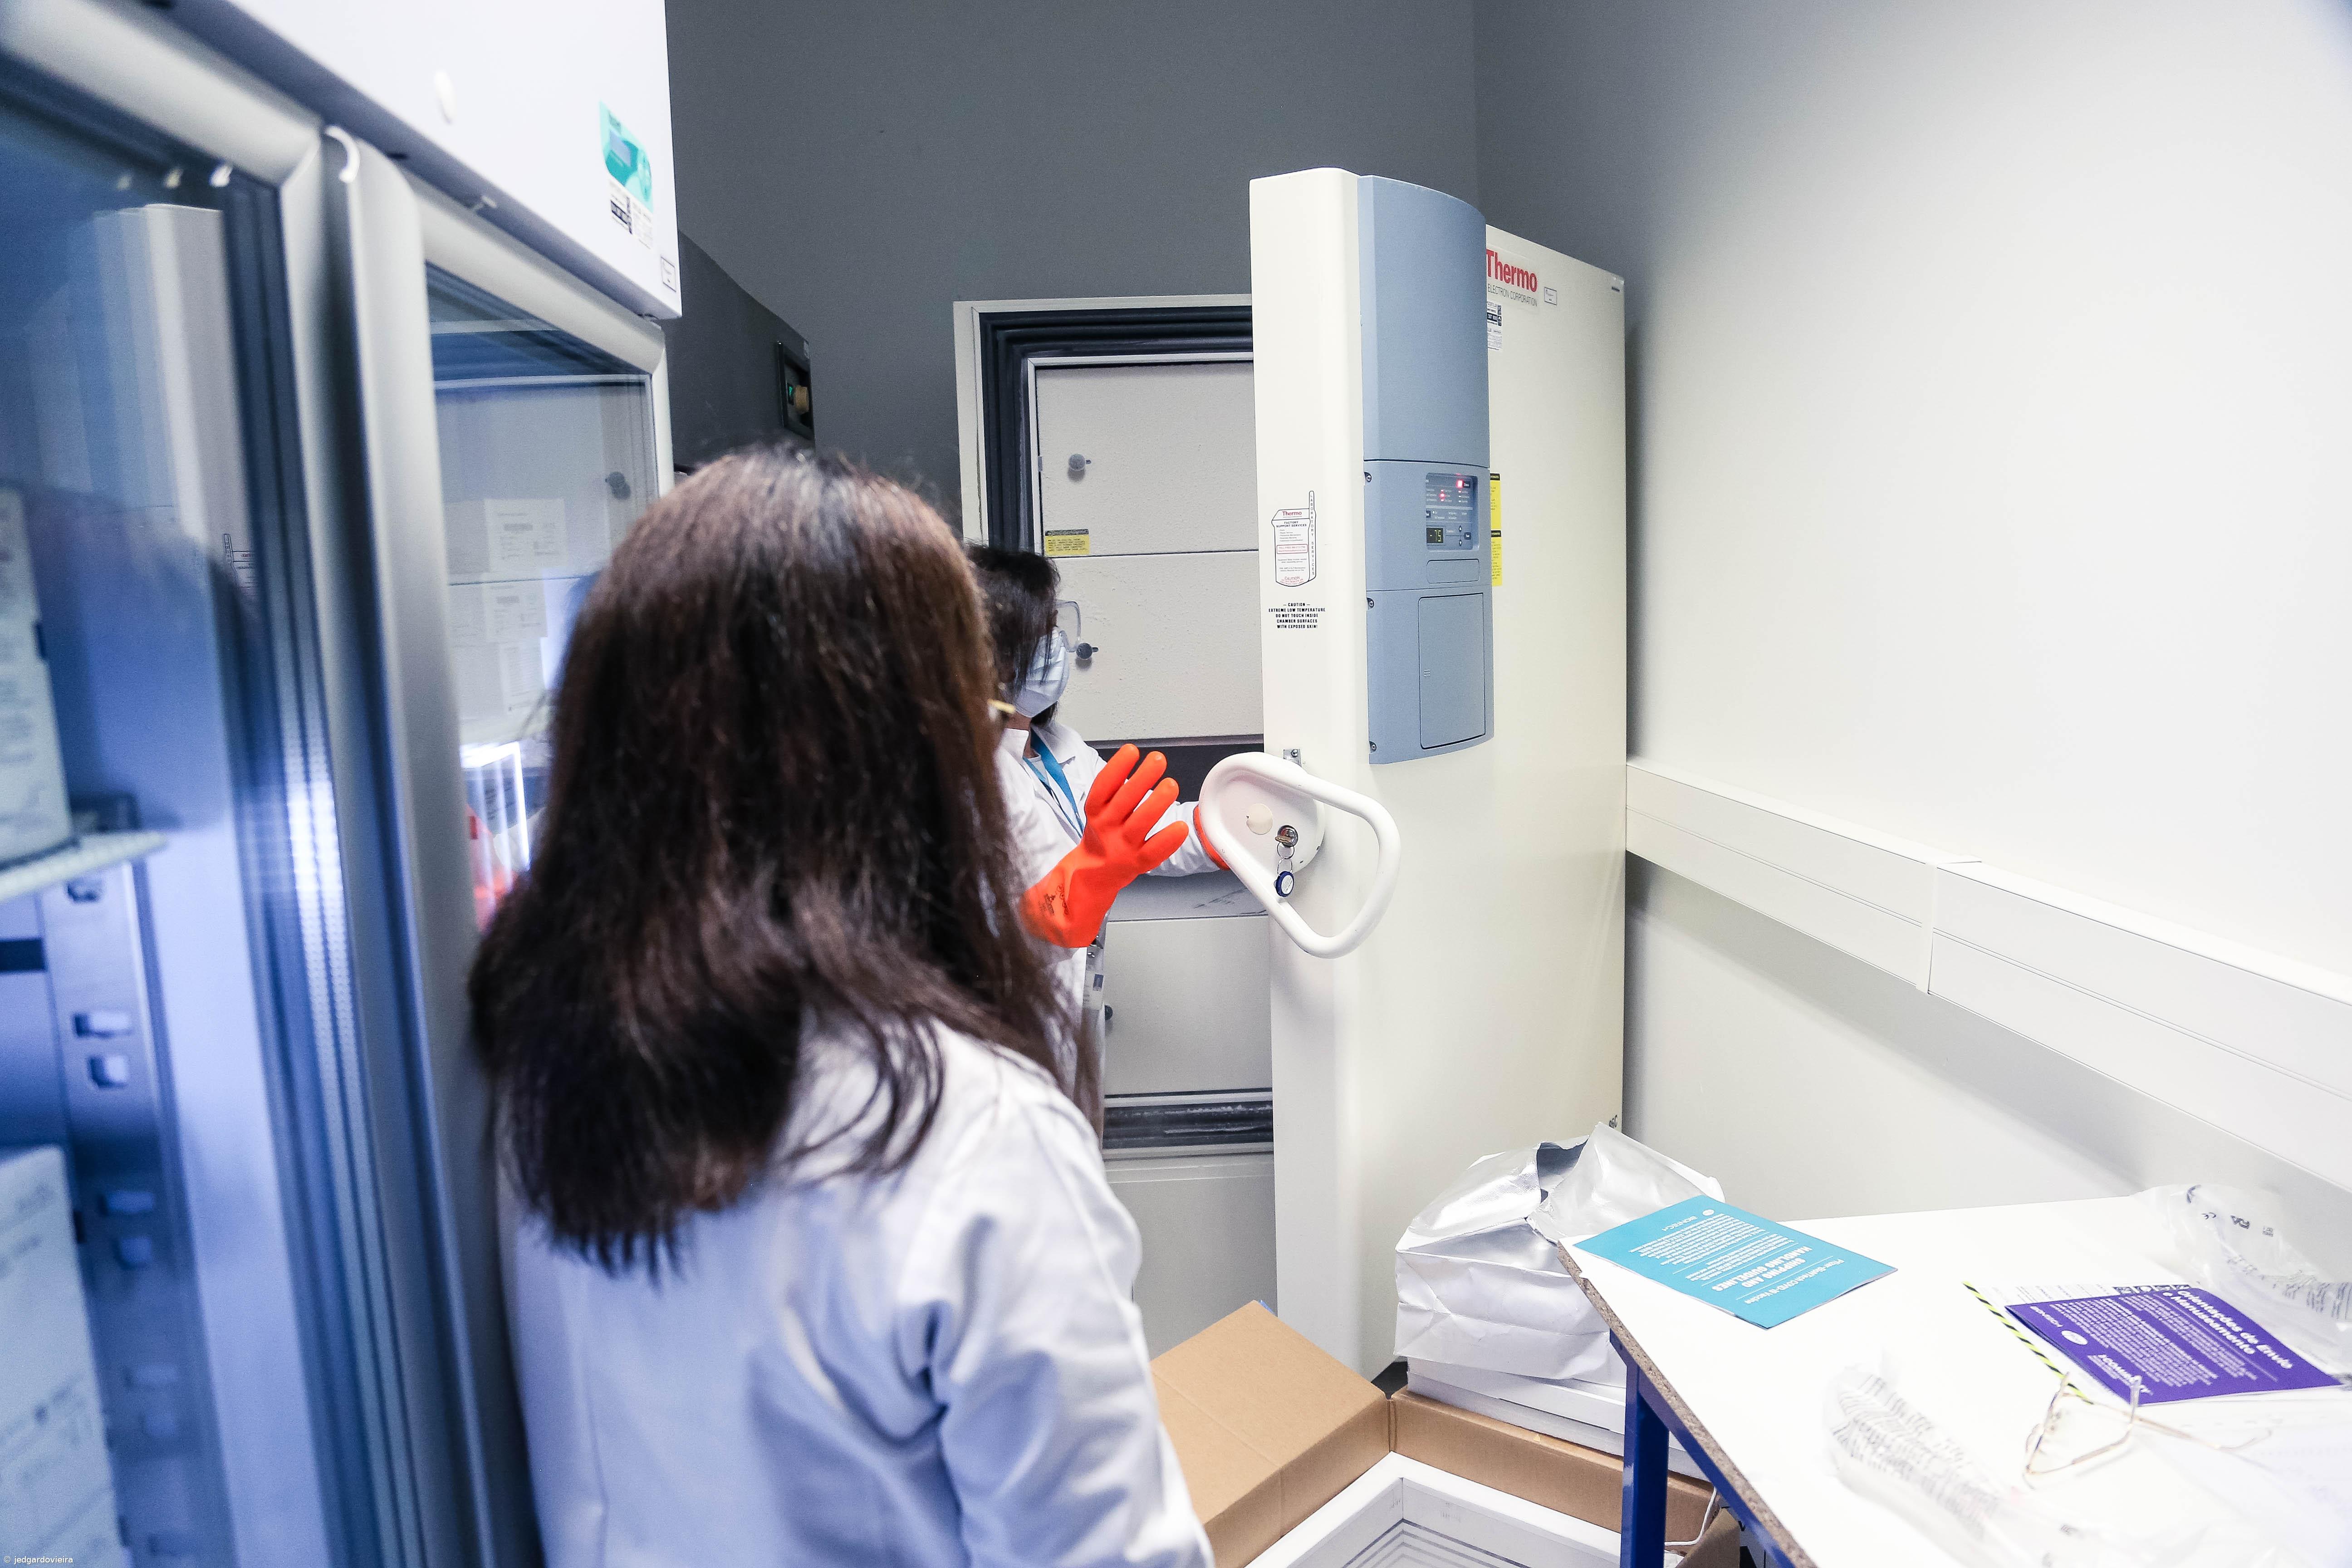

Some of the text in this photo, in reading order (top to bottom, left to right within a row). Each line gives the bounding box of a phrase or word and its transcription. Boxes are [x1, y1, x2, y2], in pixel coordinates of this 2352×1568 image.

[1486, 249, 1537, 292] Thermo
[1488, 284, 1509, 298] ELECTRON
[1510, 291, 1537, 307] CORPORATION
[1741, 1258, 1806, 1288] SHIPPING AND
[1764, 1246, 1813, 1268] HANDLING
[1712, 1266, 1768, 1291] GUIDELINES
[1744, 1259, 1845, 1304] Pfizer-BioNTech COVID-19 Vaccine
[2171, 1296, 2255, 1354] Manuseamento
[2240, 1332, 2259, 1344] de
[2256, 1344, 2293, 1369] Envio
